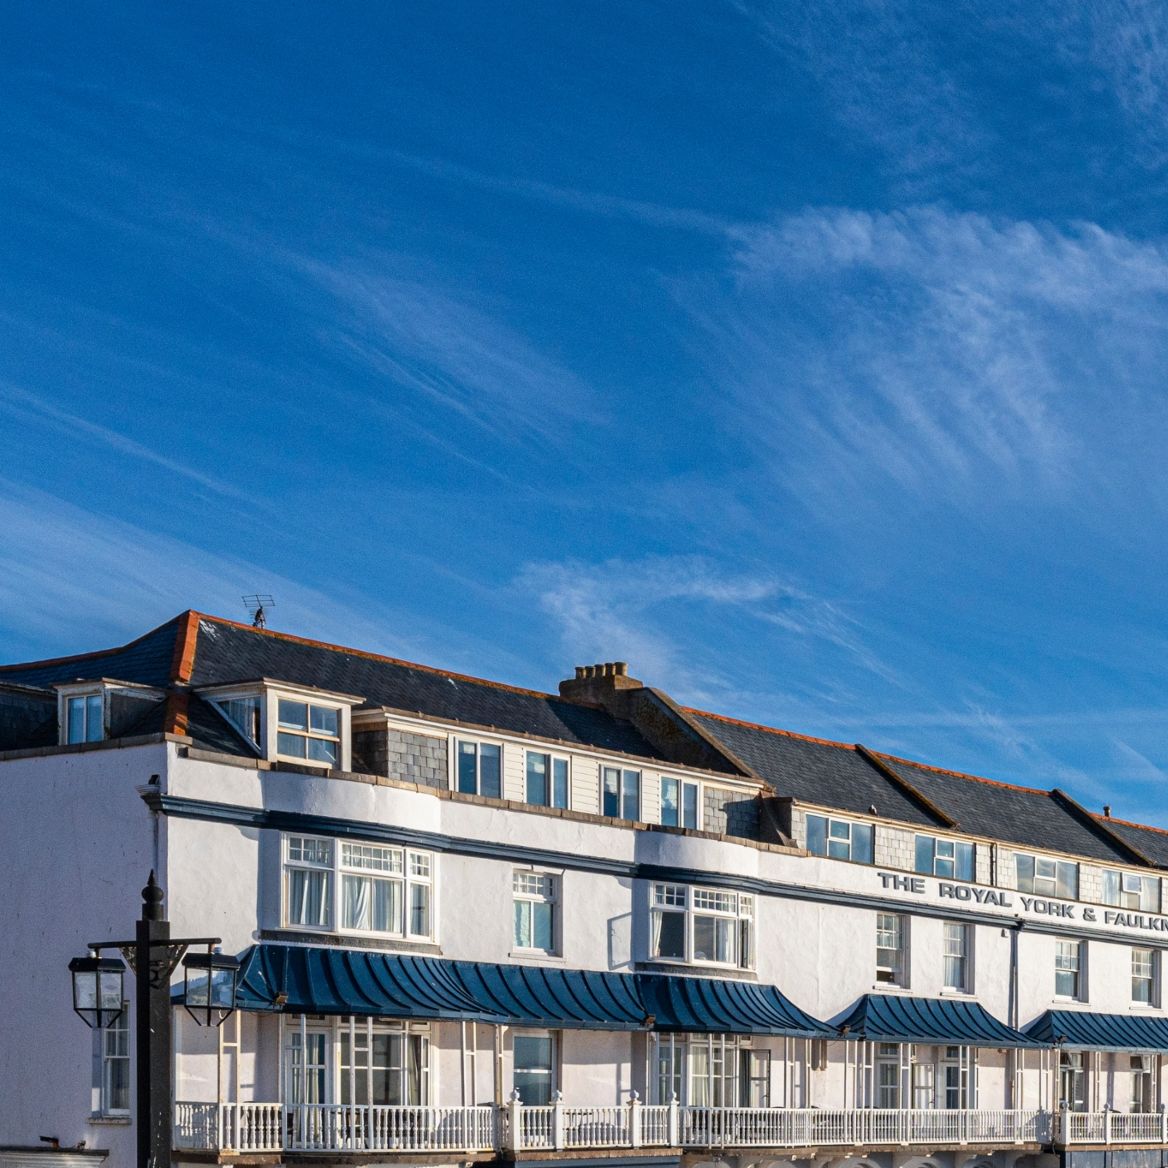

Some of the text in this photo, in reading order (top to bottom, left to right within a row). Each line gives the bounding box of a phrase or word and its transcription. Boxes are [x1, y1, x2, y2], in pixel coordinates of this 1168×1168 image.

[877, 872, 926, 894] THE
[939, 882, 1013, 908] ROYAL
[1020, 896, 1075, 919] YORK
[1082, 907, 1097, 922] &
